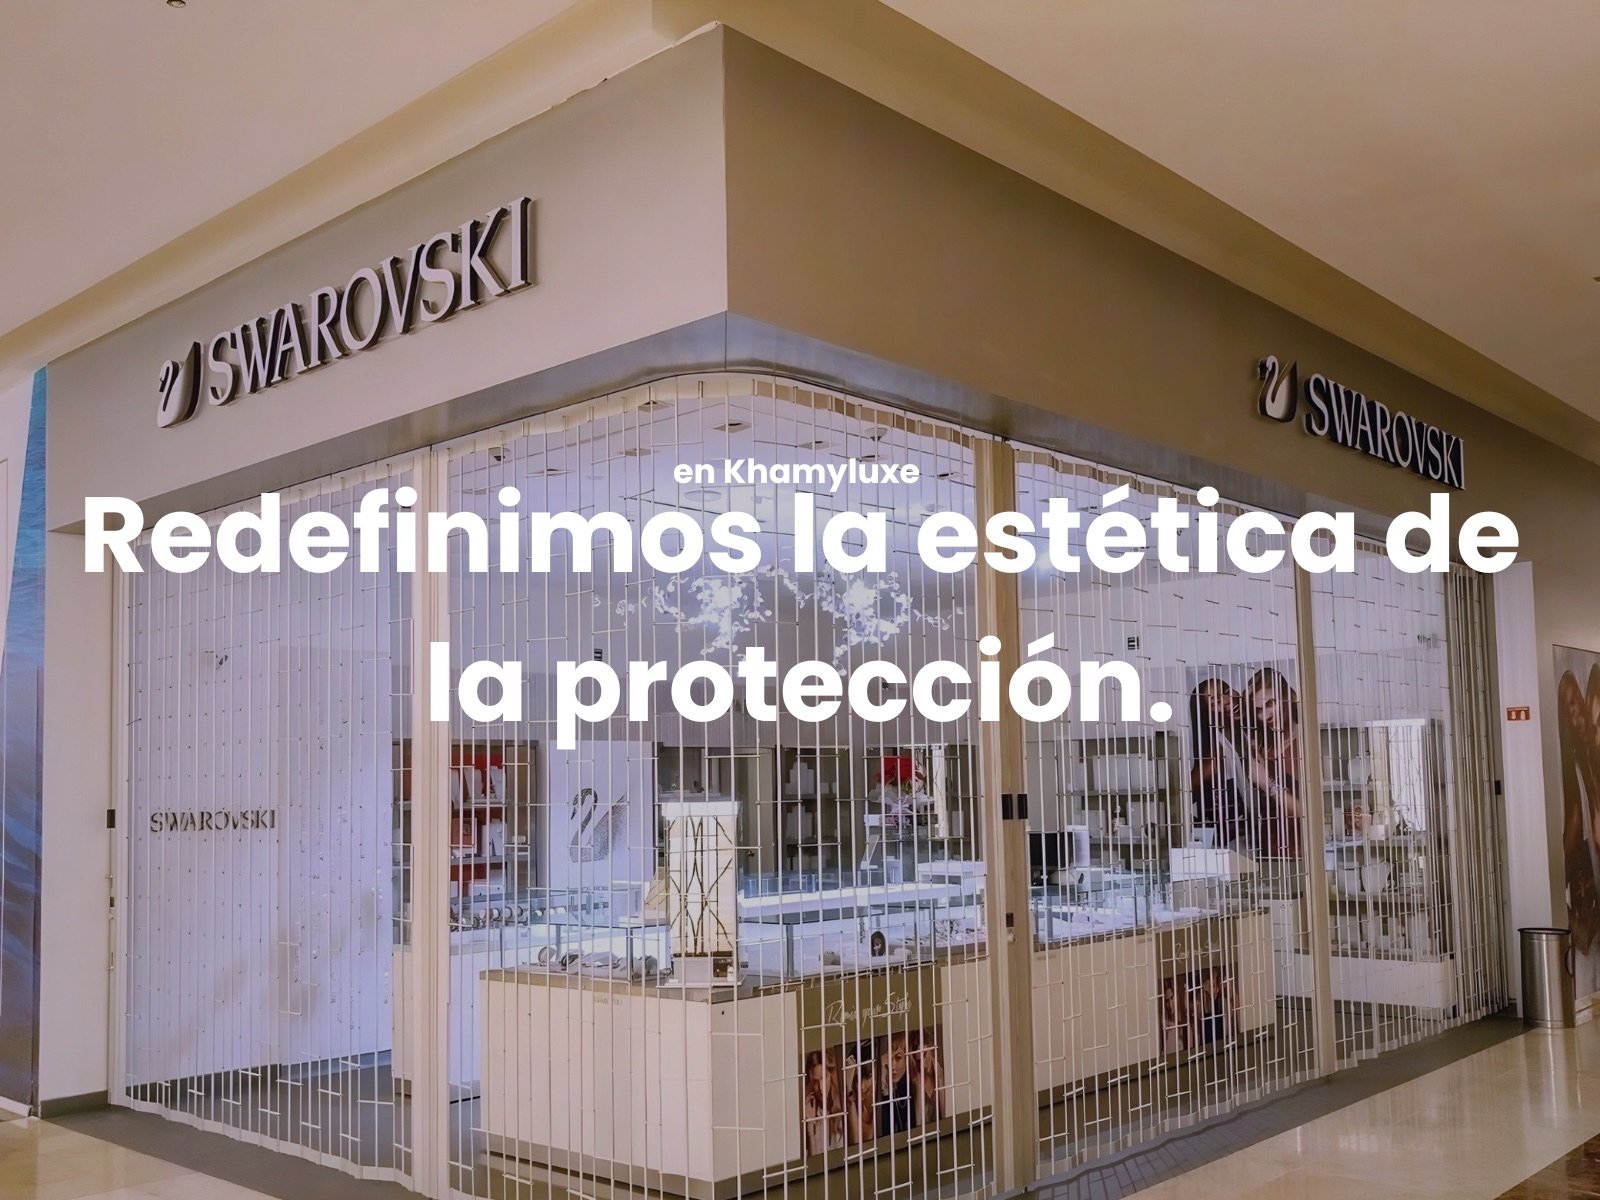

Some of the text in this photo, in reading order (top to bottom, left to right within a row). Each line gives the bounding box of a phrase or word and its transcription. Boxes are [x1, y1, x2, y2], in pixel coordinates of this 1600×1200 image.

[208, 197, 533, 406] SWAROVSKI
[1304, 373, 1466, 490] SWAROVSKI
[150, 809, 276, 832] SWAROVSKI
